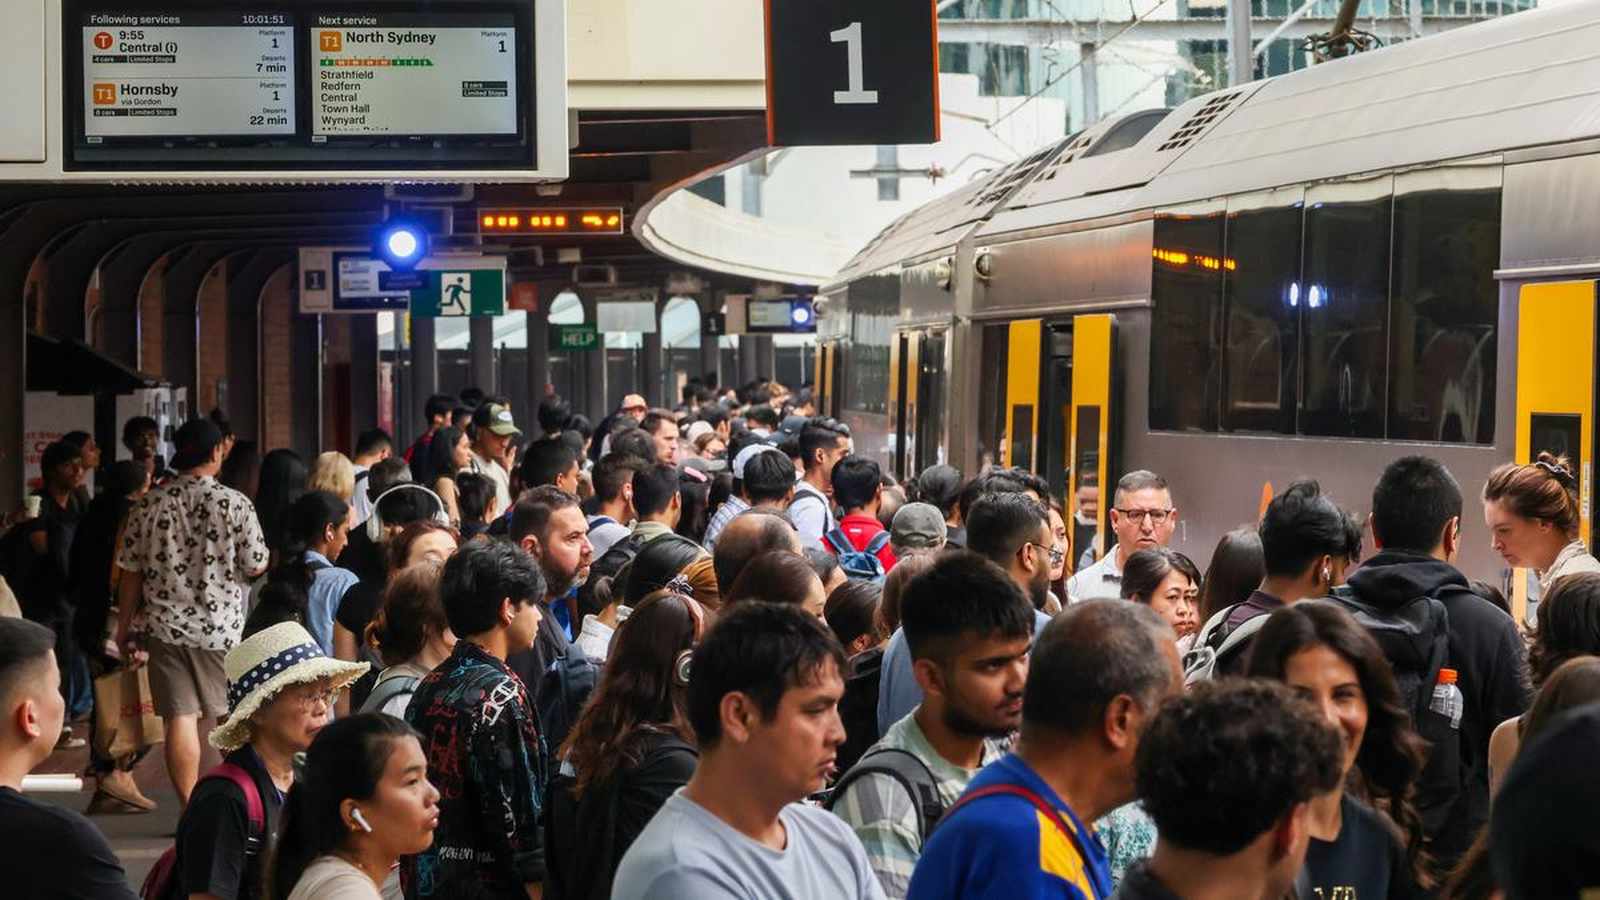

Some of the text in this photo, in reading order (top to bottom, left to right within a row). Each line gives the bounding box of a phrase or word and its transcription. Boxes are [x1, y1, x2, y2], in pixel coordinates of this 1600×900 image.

[91, 15, 180, 25] Following services
[242, 15, 285, 24] 10:01:51
[318, 16, 377, 25] Next service
[119, 31, 145, 40] 9:55
[346, 31, 436, 45] North Sydney
[98, 35, 109, 47] T
[272, 38, 279, 48] 1
[323, 36, 340, 47] T1
[498, 40, 507, 52] 1
[119, 42, 178, 53] Central (i)
[256, 63, 287, 73] 7 min
[830, 22, 878, 104] 1
[320, 70, 374, 80] Strathfield
[121, 83, 178, 97] Hornsby
[320, 81, 361, 91] Redfern
[96, 88, 114, 100] T1
[273, 91, 280, 101] 1
[321, 92, 357, 102] Central
[134, 97, 162, 105] Gordon
[321, 104, 370, 113] Town Hall
[249, 116, 288, 126] 22 min
[321, 115, 366, 126] Wynyard
[562, 333, 595, 346] HELP
